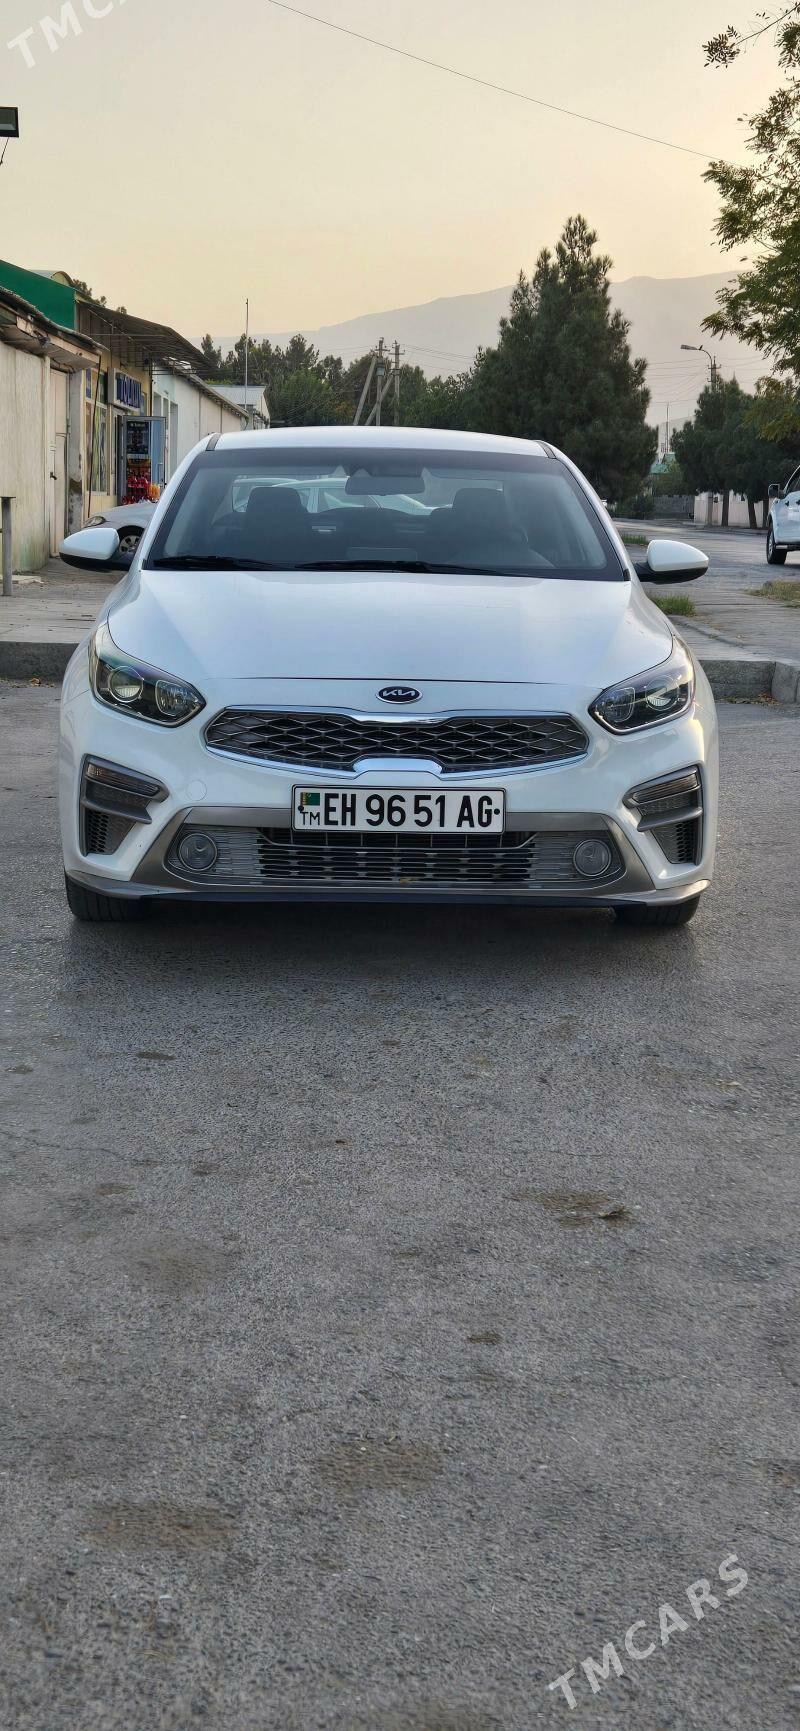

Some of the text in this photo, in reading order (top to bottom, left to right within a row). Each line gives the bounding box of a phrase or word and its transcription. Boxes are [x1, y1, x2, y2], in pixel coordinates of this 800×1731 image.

[300, 811, 321, 826] TM
[324, 792, 493, 828] EH 96 51 AG
